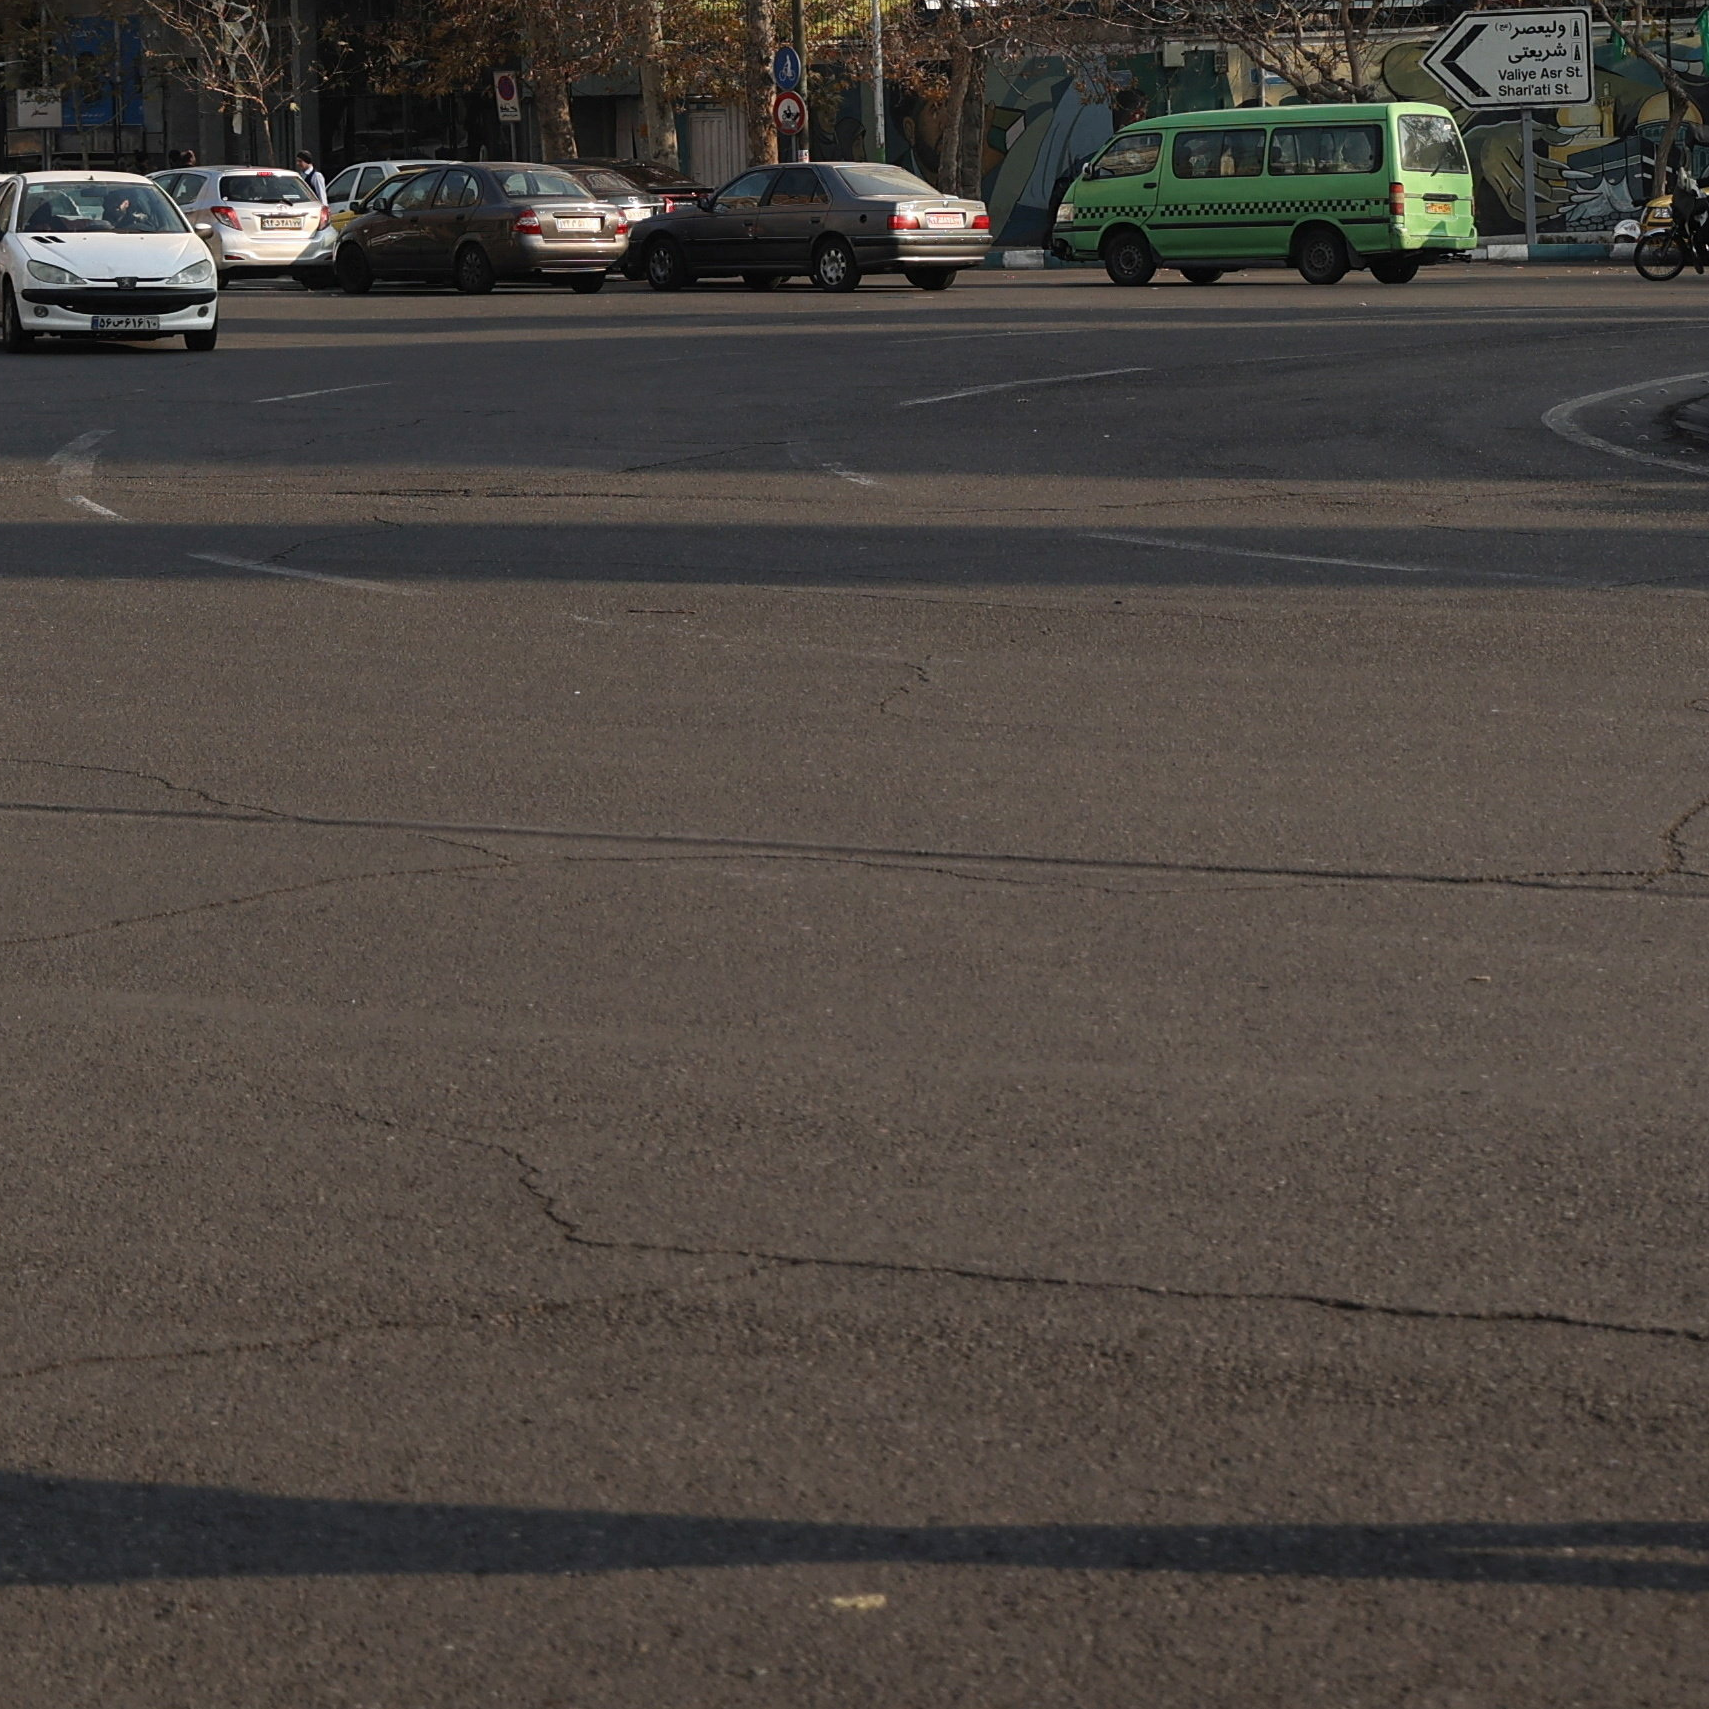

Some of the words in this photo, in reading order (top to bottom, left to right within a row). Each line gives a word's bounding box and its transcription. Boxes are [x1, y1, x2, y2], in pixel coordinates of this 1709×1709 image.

[1510, 20, 1566, 40] ولیعصر
[1508, 42, 1567, 64] شریعتی
[1498, 68, 1537, 82] Valiye
[1540, 67, 1563, 79] Asr
[1566, 66, 1583, 78] St.
[1498, 83, 1551, 97] Shari'ati
[1554, 83, 1572, 95] St.
